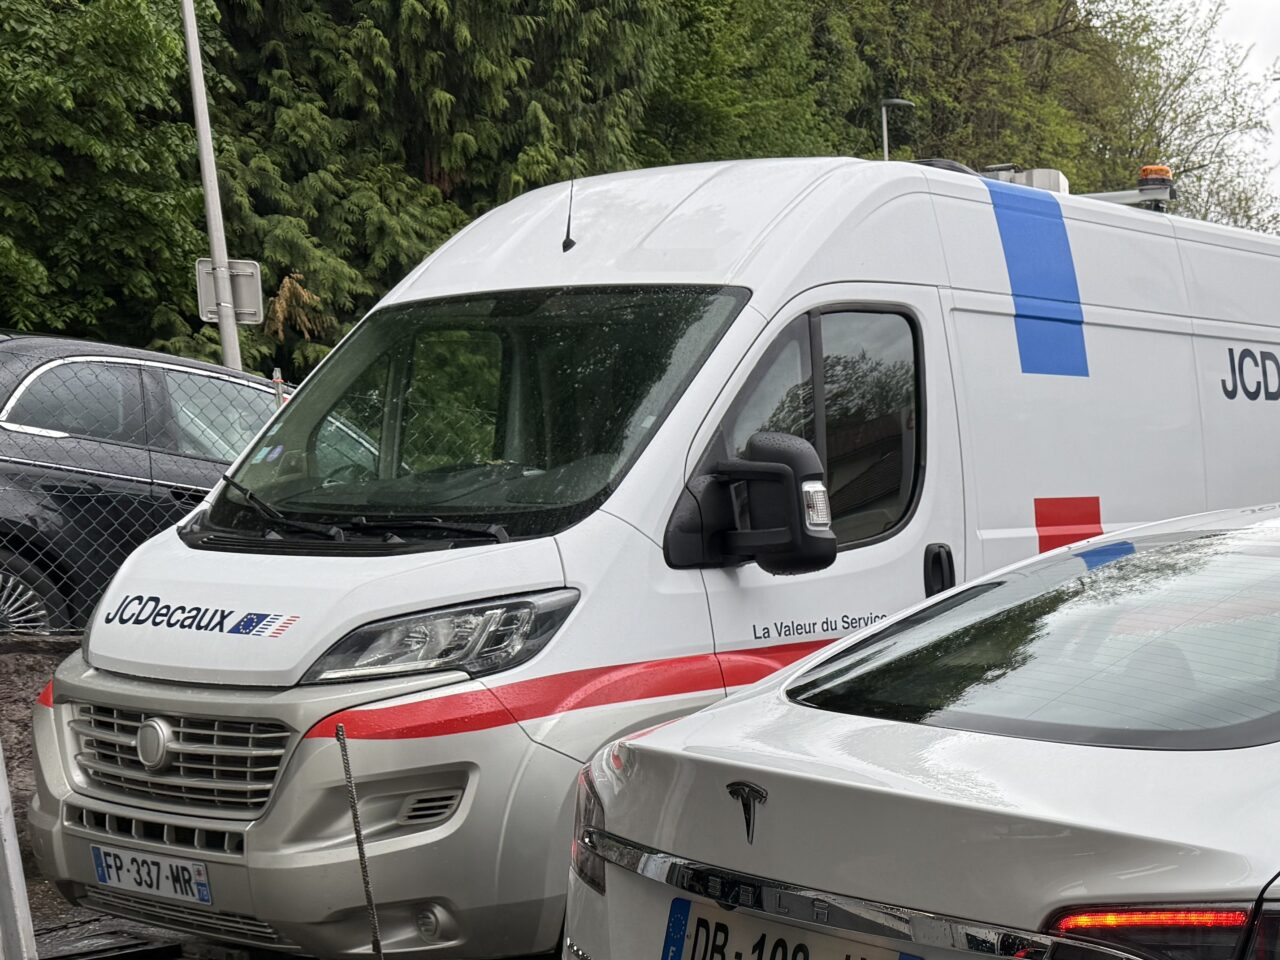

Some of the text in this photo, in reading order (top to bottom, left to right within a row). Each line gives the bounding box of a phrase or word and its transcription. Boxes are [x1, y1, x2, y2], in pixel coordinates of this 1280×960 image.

[104, 594, 235, 633] JCDecaux
[753, 624, 770, 640] La
[774, 620, 817, 638] Valeur
[821, 617, 837, 633] du
